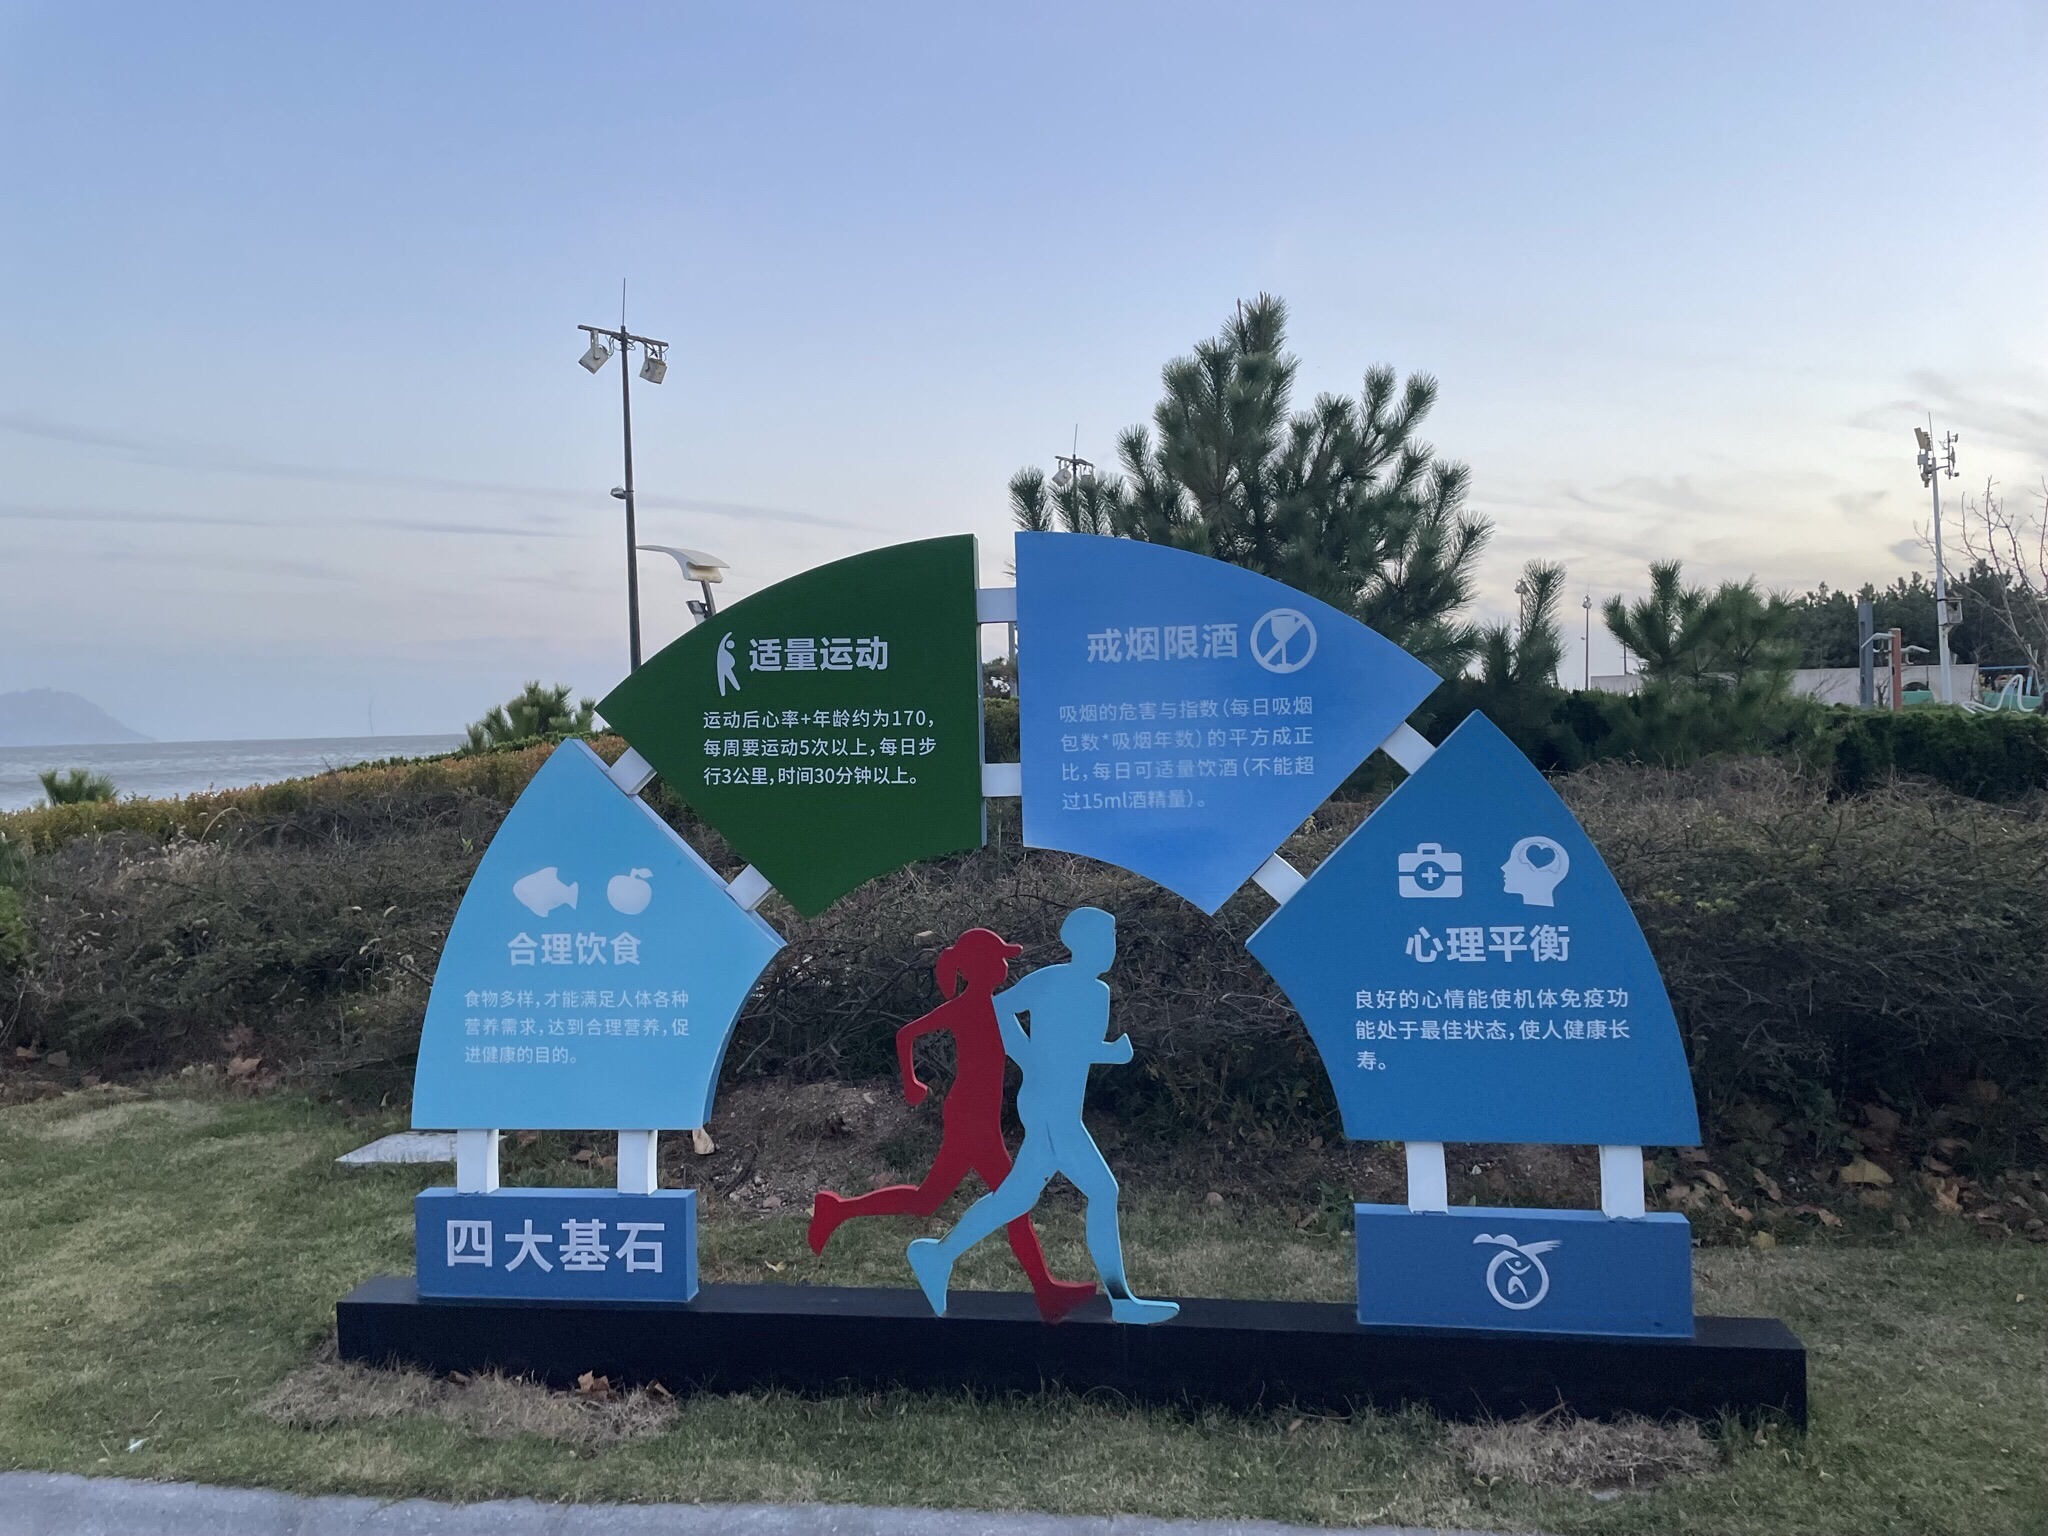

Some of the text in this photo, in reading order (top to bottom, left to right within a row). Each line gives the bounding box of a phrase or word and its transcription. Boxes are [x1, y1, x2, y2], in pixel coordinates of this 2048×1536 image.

[1087, 623, 1238, 663] 戒烟限酒
[749, 636, 888, 672] 适量运动
[703, 709, 935, 729] 运动后心率+年龄约为170，
[703, 737, 937, 758] 每周要运动5次以上，每日步
[703, 765, 917, 786] 行3公里，时间30分钟以上。
[507, 932, 642, 966] 合理饮食
[1405, 924, 1570, 963] 心理平衡
[464, 990, 689, 1008] 食物多样，才能满足人体各种
[1355, 988, 1629, 1009] 良好的心情能使机体免疫功
[464, 1018, 690, 1037] 营养需求，达到合理营养，促
[1355, 1019, 1630, 1041] 能处于最佳状态，使人健康长
[464, 1046, 577, 1064] 进健康的目的。
[1356, 1051, 1386, 1070] 寿。
[447, 1218, 665, 1273] 四大基石
